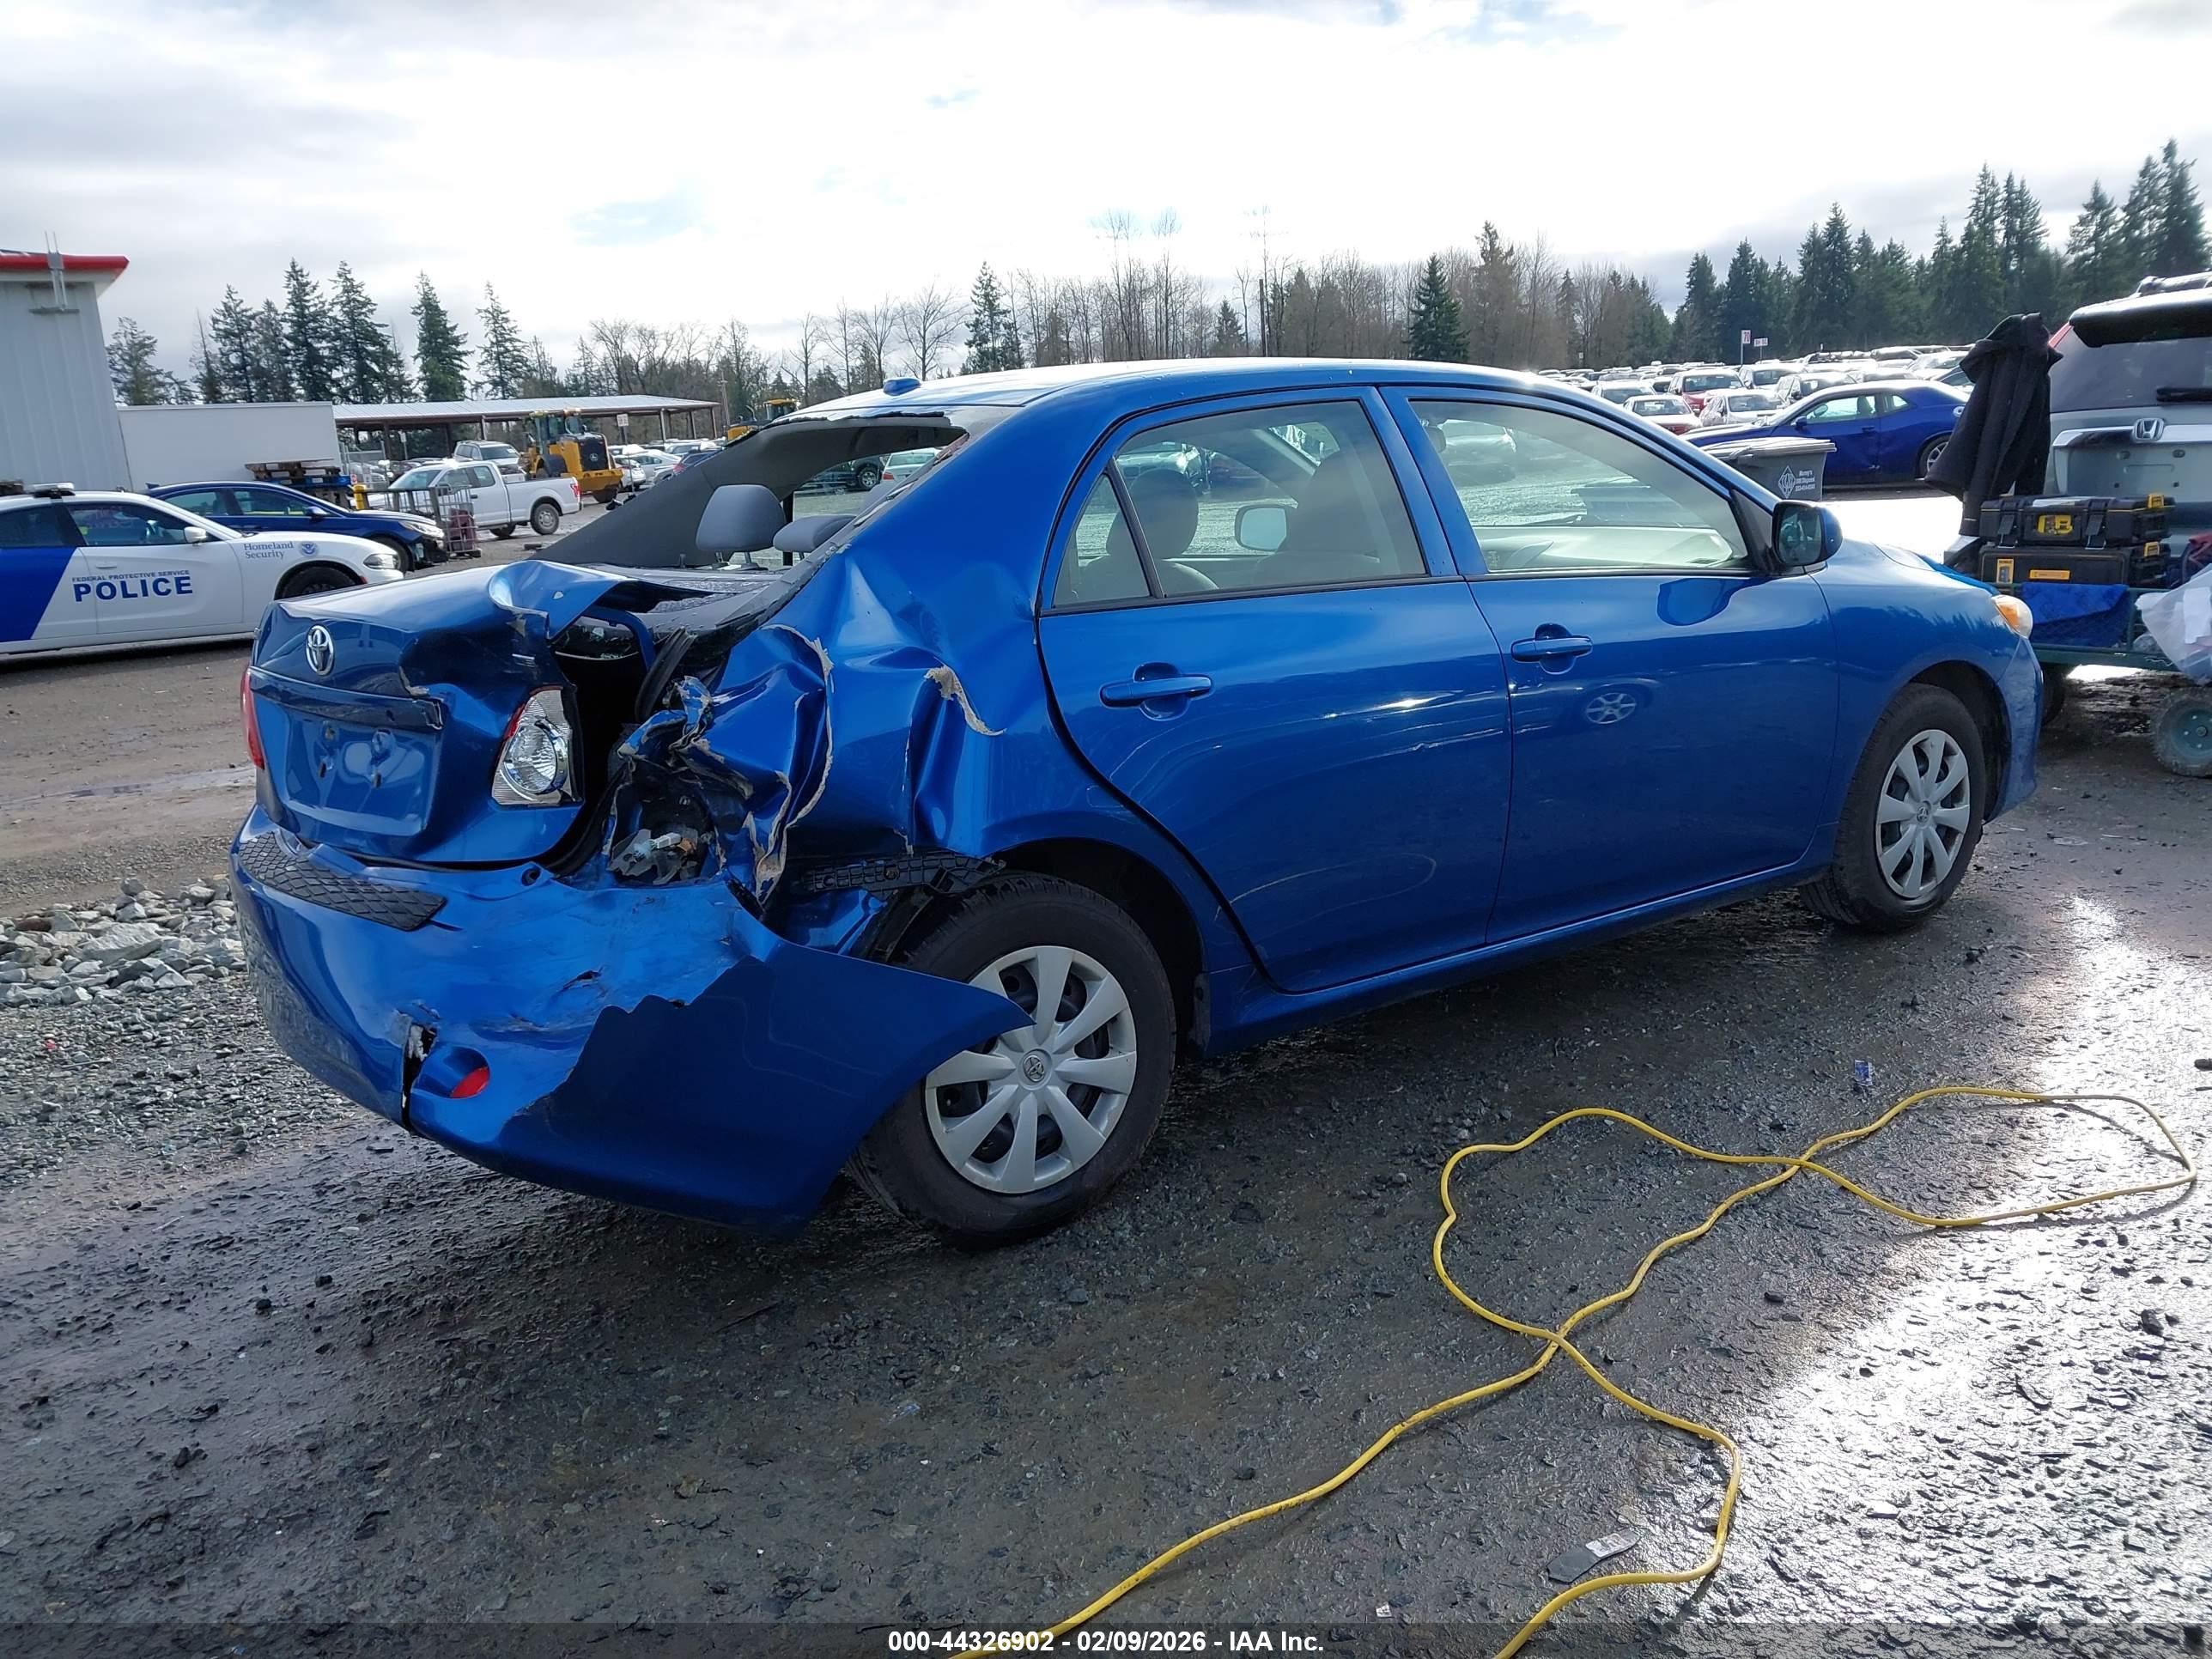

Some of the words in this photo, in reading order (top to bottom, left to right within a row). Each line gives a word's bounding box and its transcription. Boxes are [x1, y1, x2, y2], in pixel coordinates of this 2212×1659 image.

[244, 541, 294, 550] Homeland
[245, 550, 284, 561] Security
[109, 571, 155, 580] PROTECTIVE
[73, 576, 193, 602] POLICE
